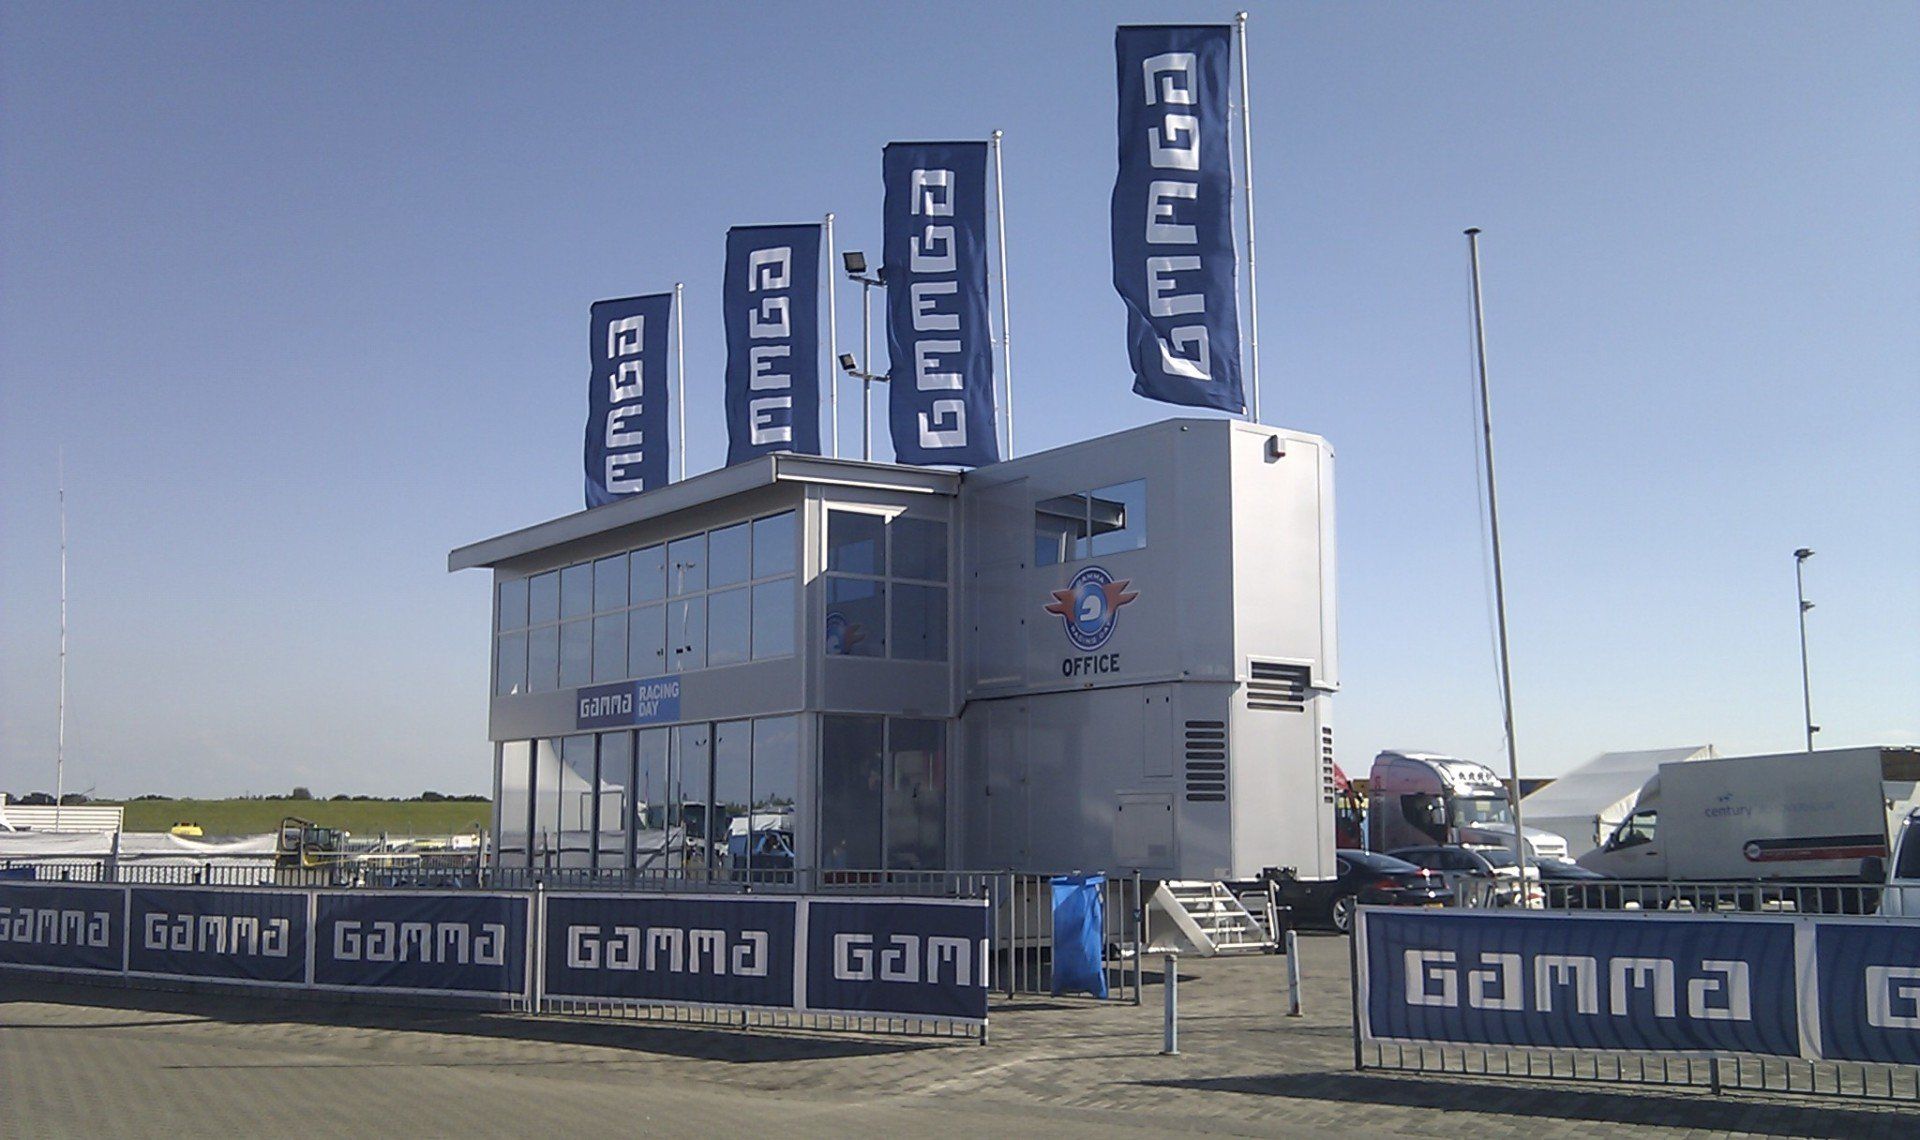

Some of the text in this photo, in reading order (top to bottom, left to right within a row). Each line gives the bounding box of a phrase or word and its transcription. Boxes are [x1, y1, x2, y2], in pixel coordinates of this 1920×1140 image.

[1062, 653, 1120, 677] OFFICE
[639, 682, 680, 701] RACING
[638, 701, 660, 717] DAY
